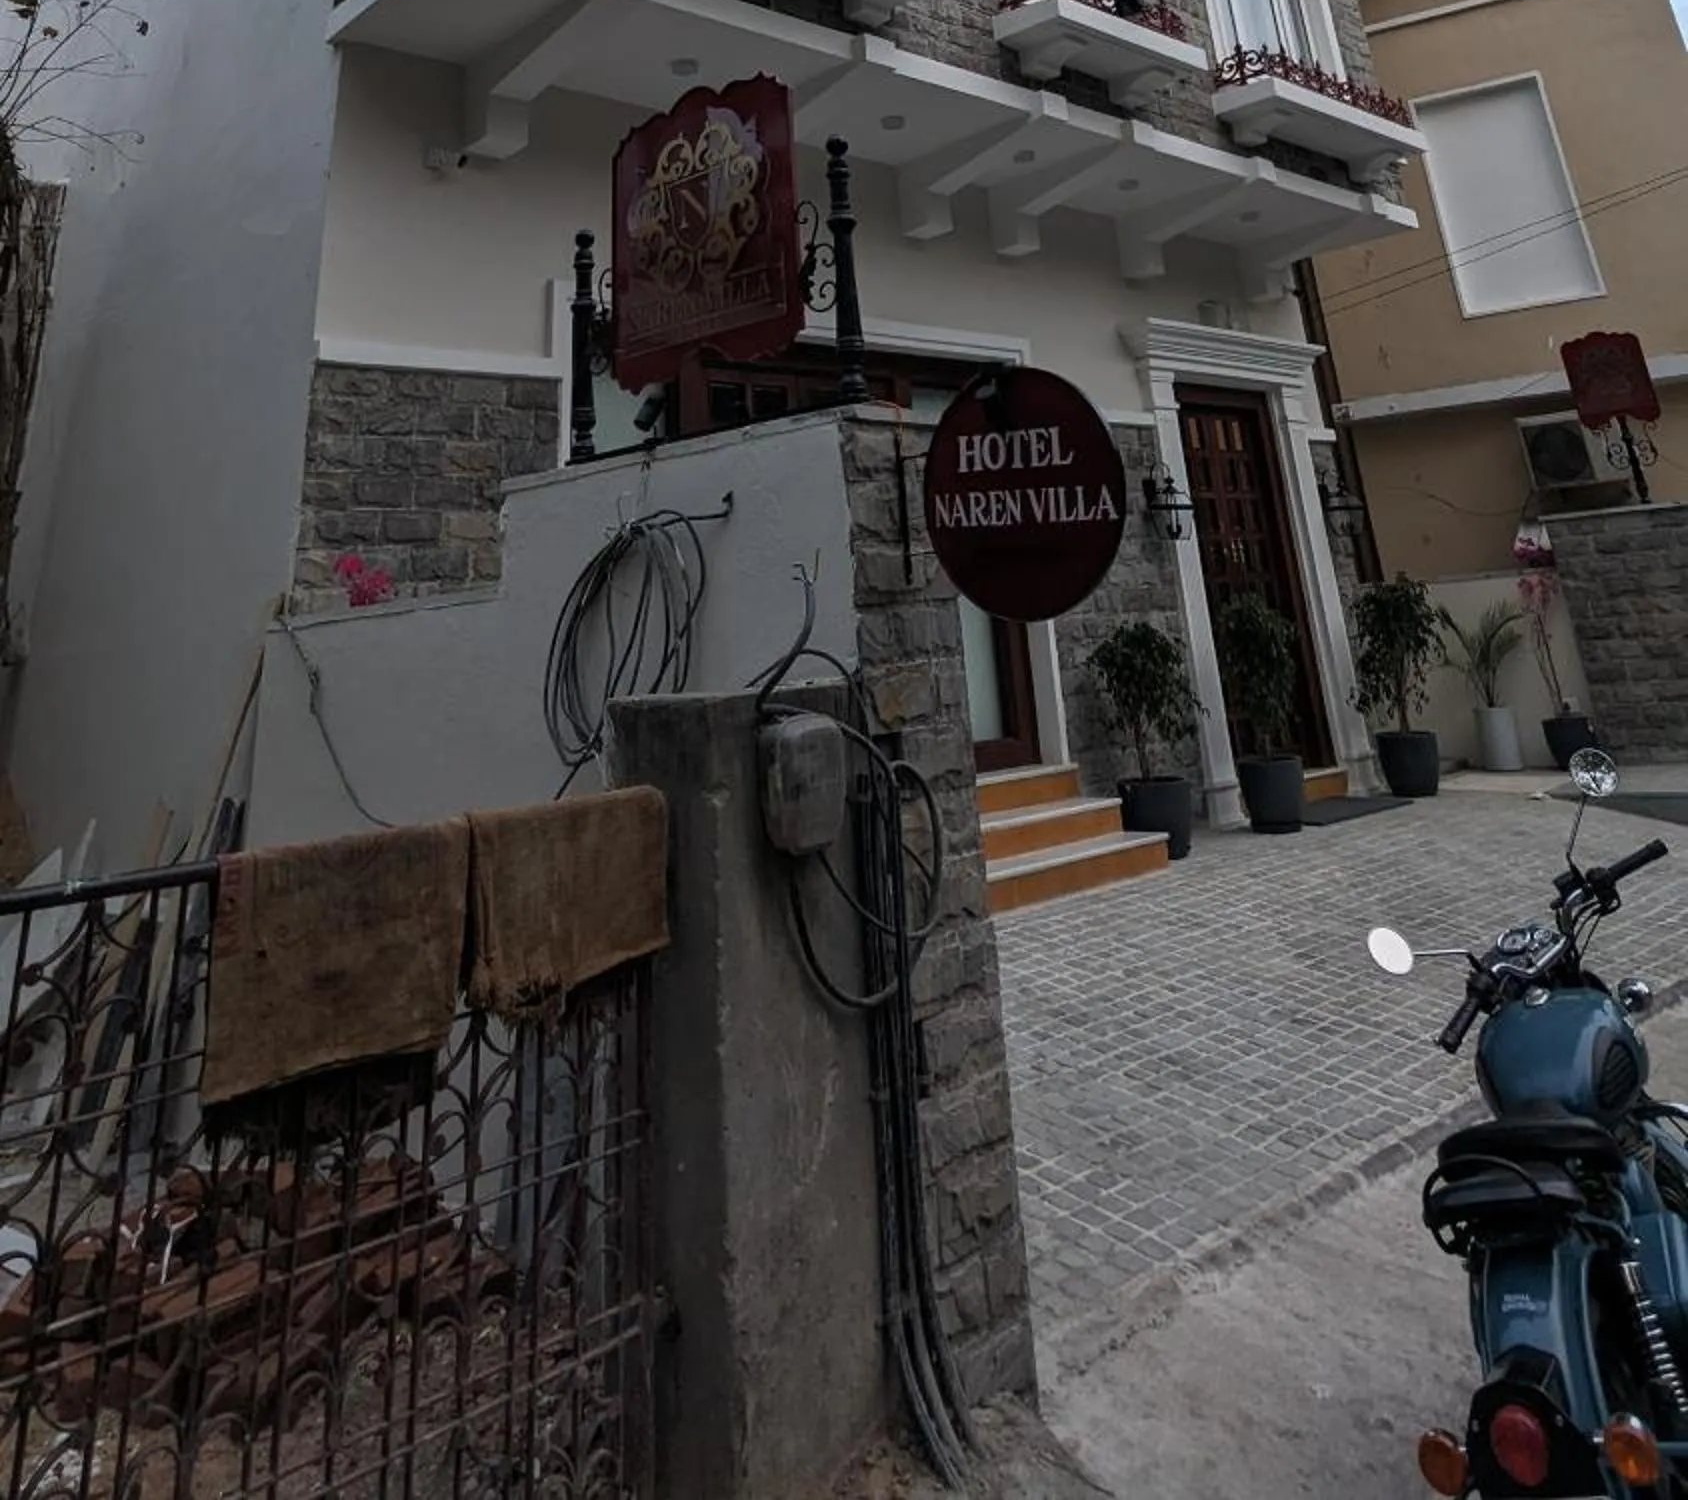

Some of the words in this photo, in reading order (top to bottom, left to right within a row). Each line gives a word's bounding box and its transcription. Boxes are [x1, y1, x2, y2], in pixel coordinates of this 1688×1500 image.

[957, 426, 1073, 473] HOTEL
[935, 488, 1022, 528] NAREN
[1026, 484, 1118, 524] VILLA
